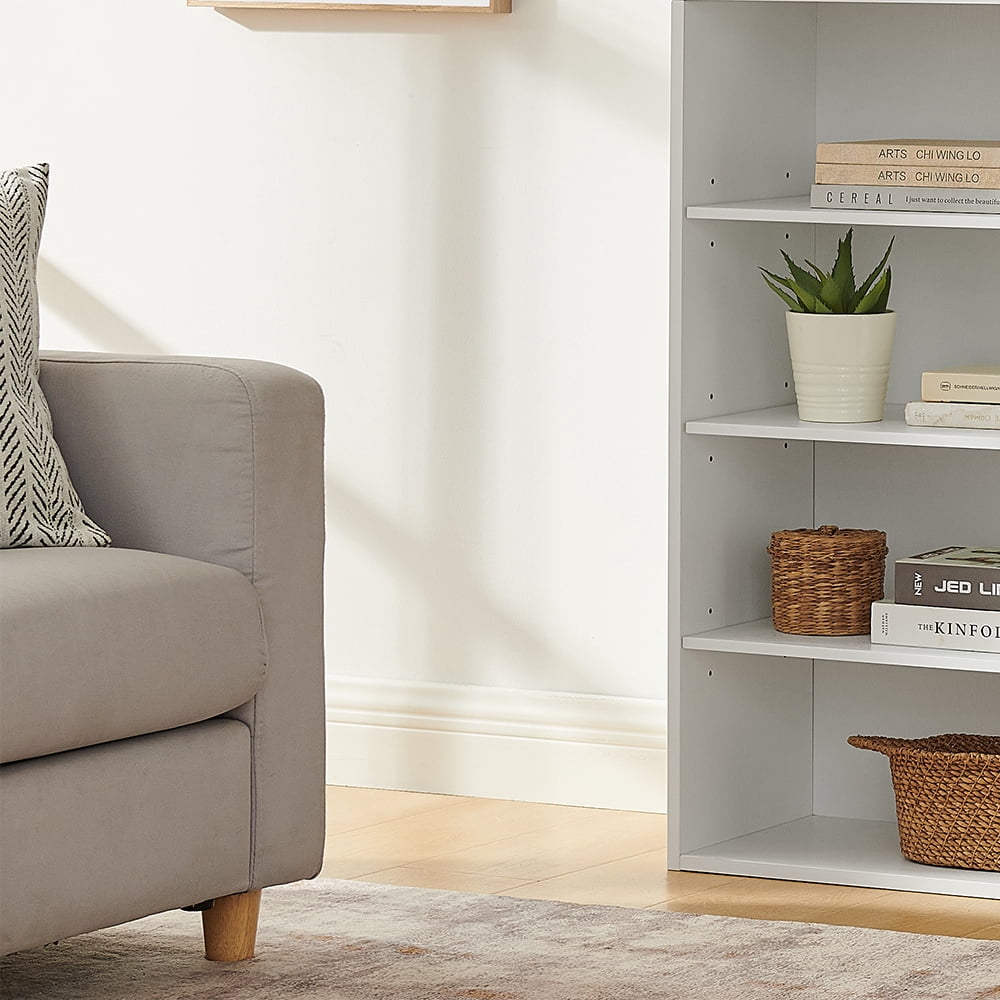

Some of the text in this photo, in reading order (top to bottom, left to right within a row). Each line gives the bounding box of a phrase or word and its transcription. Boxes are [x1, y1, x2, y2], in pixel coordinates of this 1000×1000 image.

[878, 149, 981, 161] ARTS CHI WING LO
[877, 171, 980, 183] ARTS CHI WING LO
[826, 191, 893, 205] CEREAL
[908, 196, 921, 204] just
[914, 572, 922, 596] NEW
[934, 580, 972, 594] JED
[917, 623, 934, 631] THE
